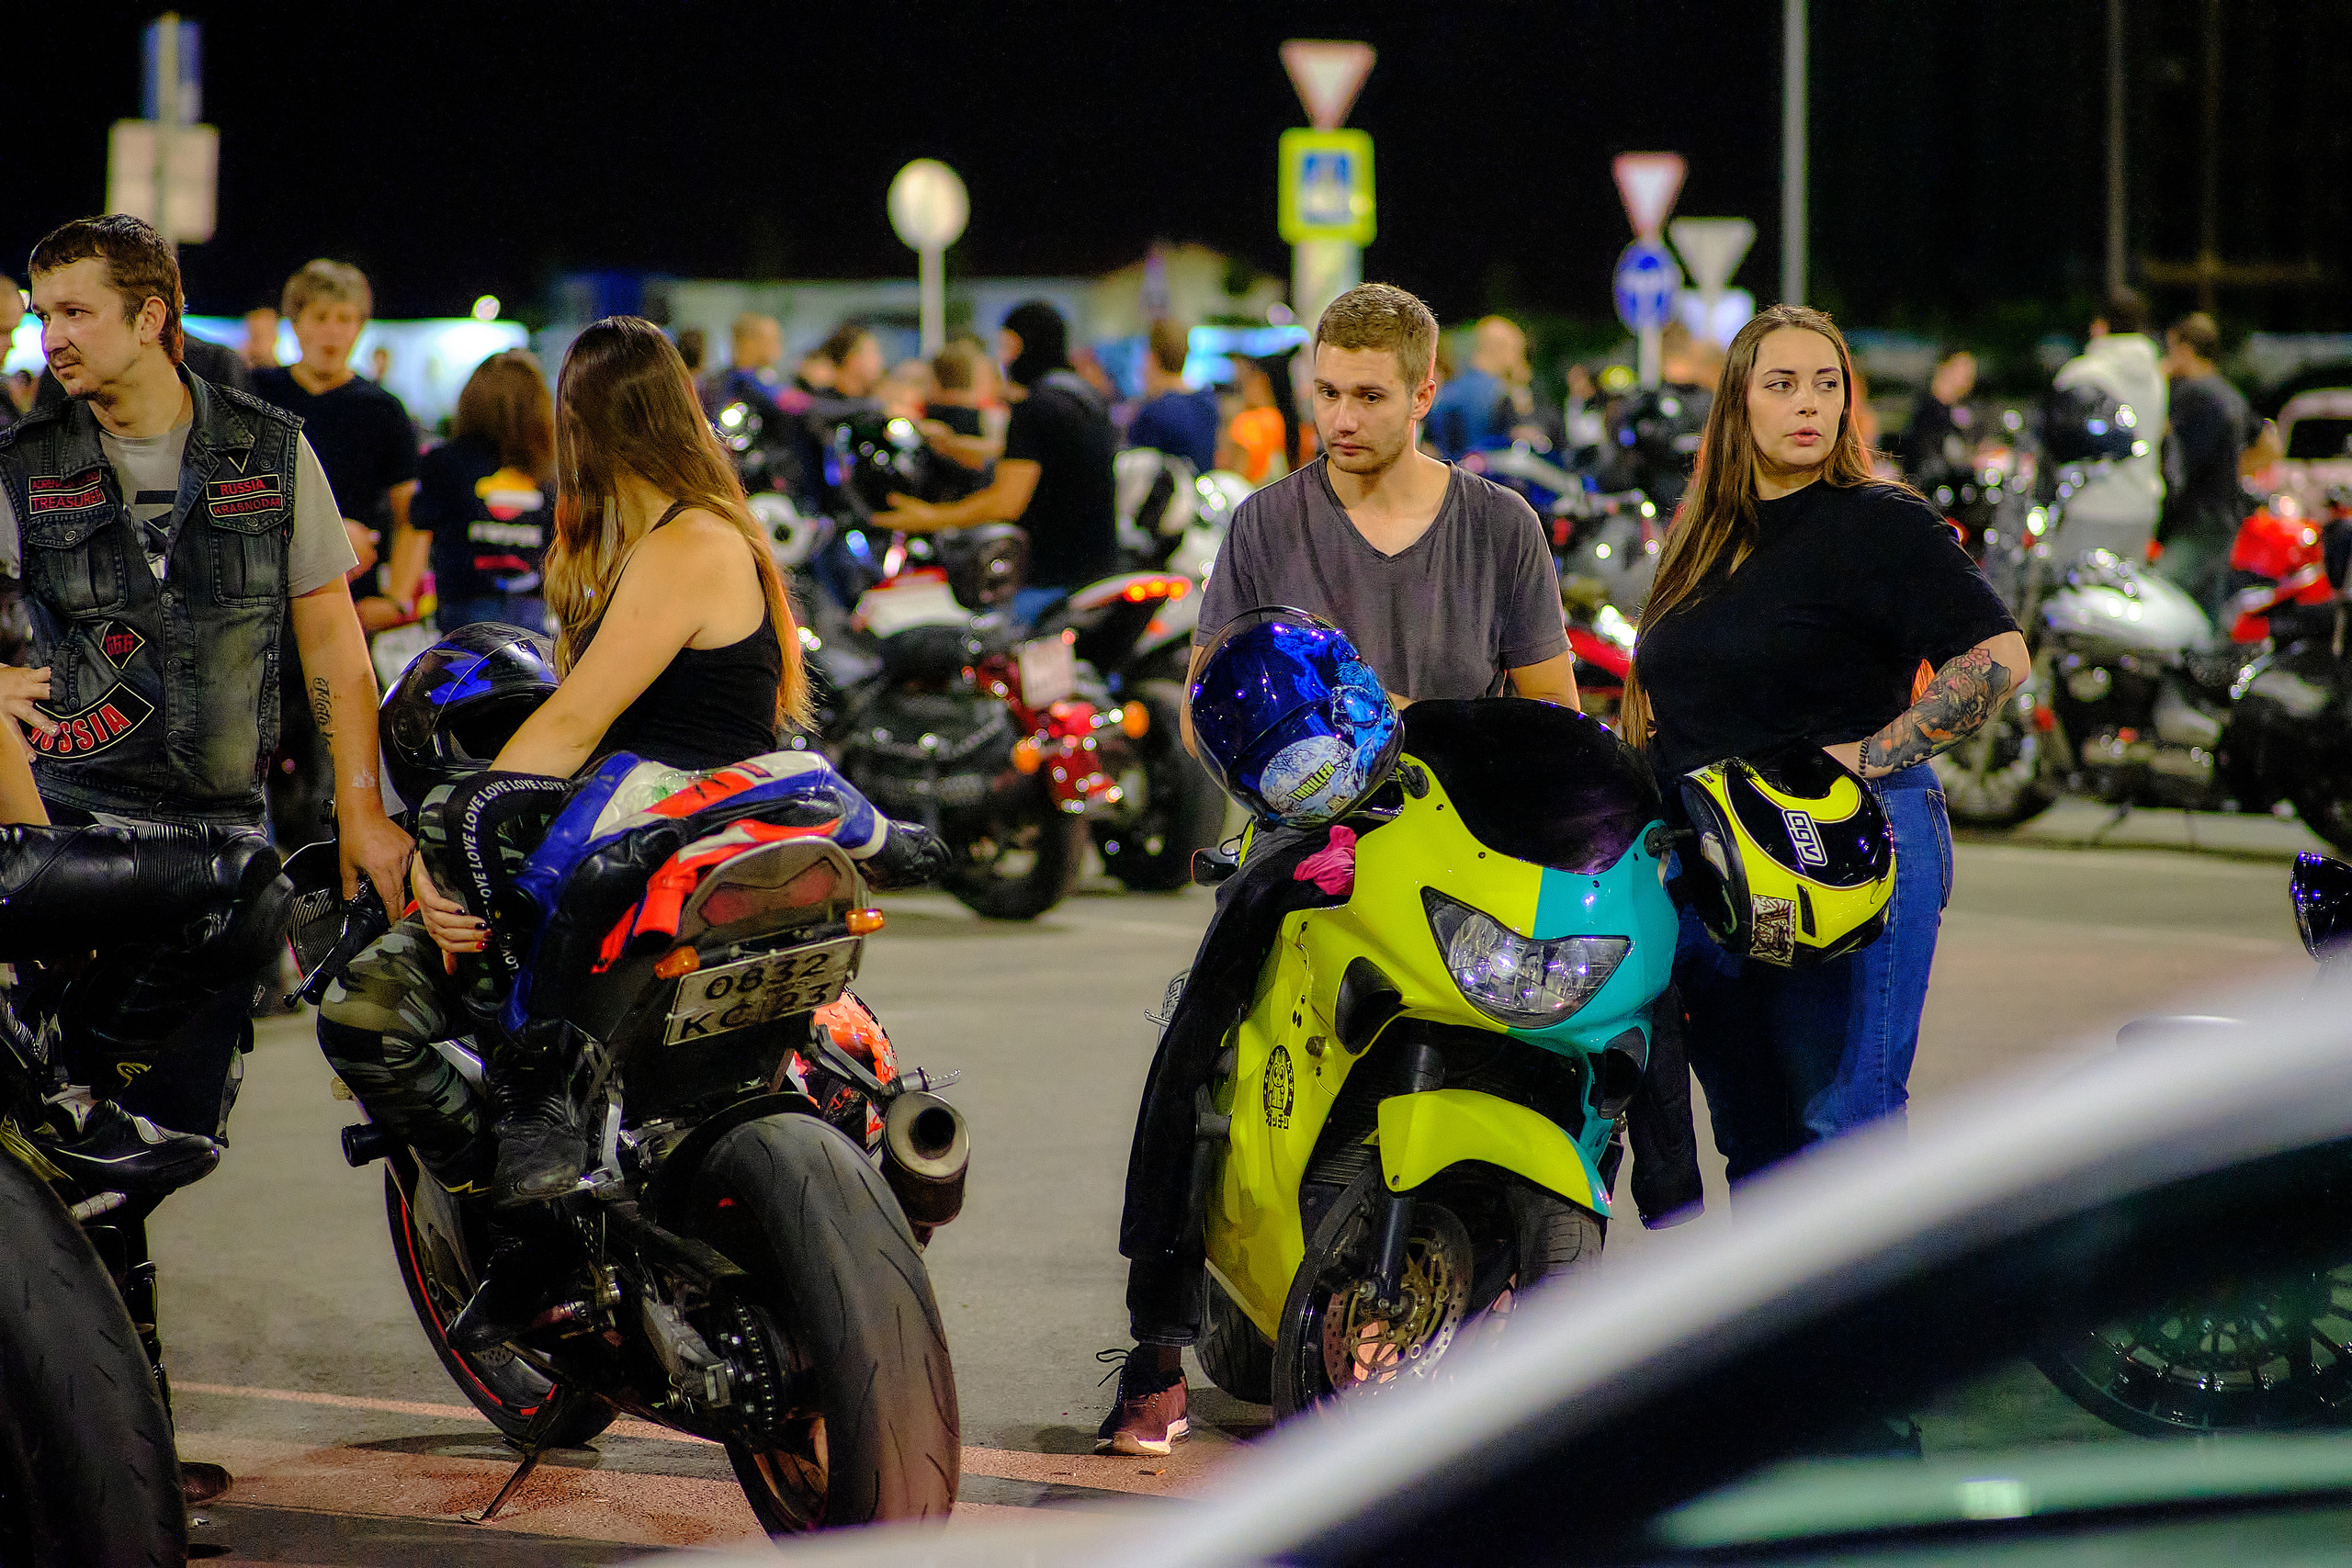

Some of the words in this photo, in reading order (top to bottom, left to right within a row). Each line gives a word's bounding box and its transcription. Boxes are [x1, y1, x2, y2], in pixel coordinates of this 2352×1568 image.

[31, 488, 104, 511] TREASURER
[220, 479, 266, 495] RUSSIA
[213, 497, 281, 514] KRASNODAR
[478, 780, 512, 801] LOVE
[506, 779, 539, 790] LOVE
[536, 780, 566, 791] LOVE
[1287, 761, 1337, 802] THRILLER
[462, 795, 486, 832] LOVE
[462, 832, 483, 869] LOVE
[1782, 809, 1827, 865] AGV
[472, 871, 492, 905] OVE
[705, 953, 829, 1000] 0832
